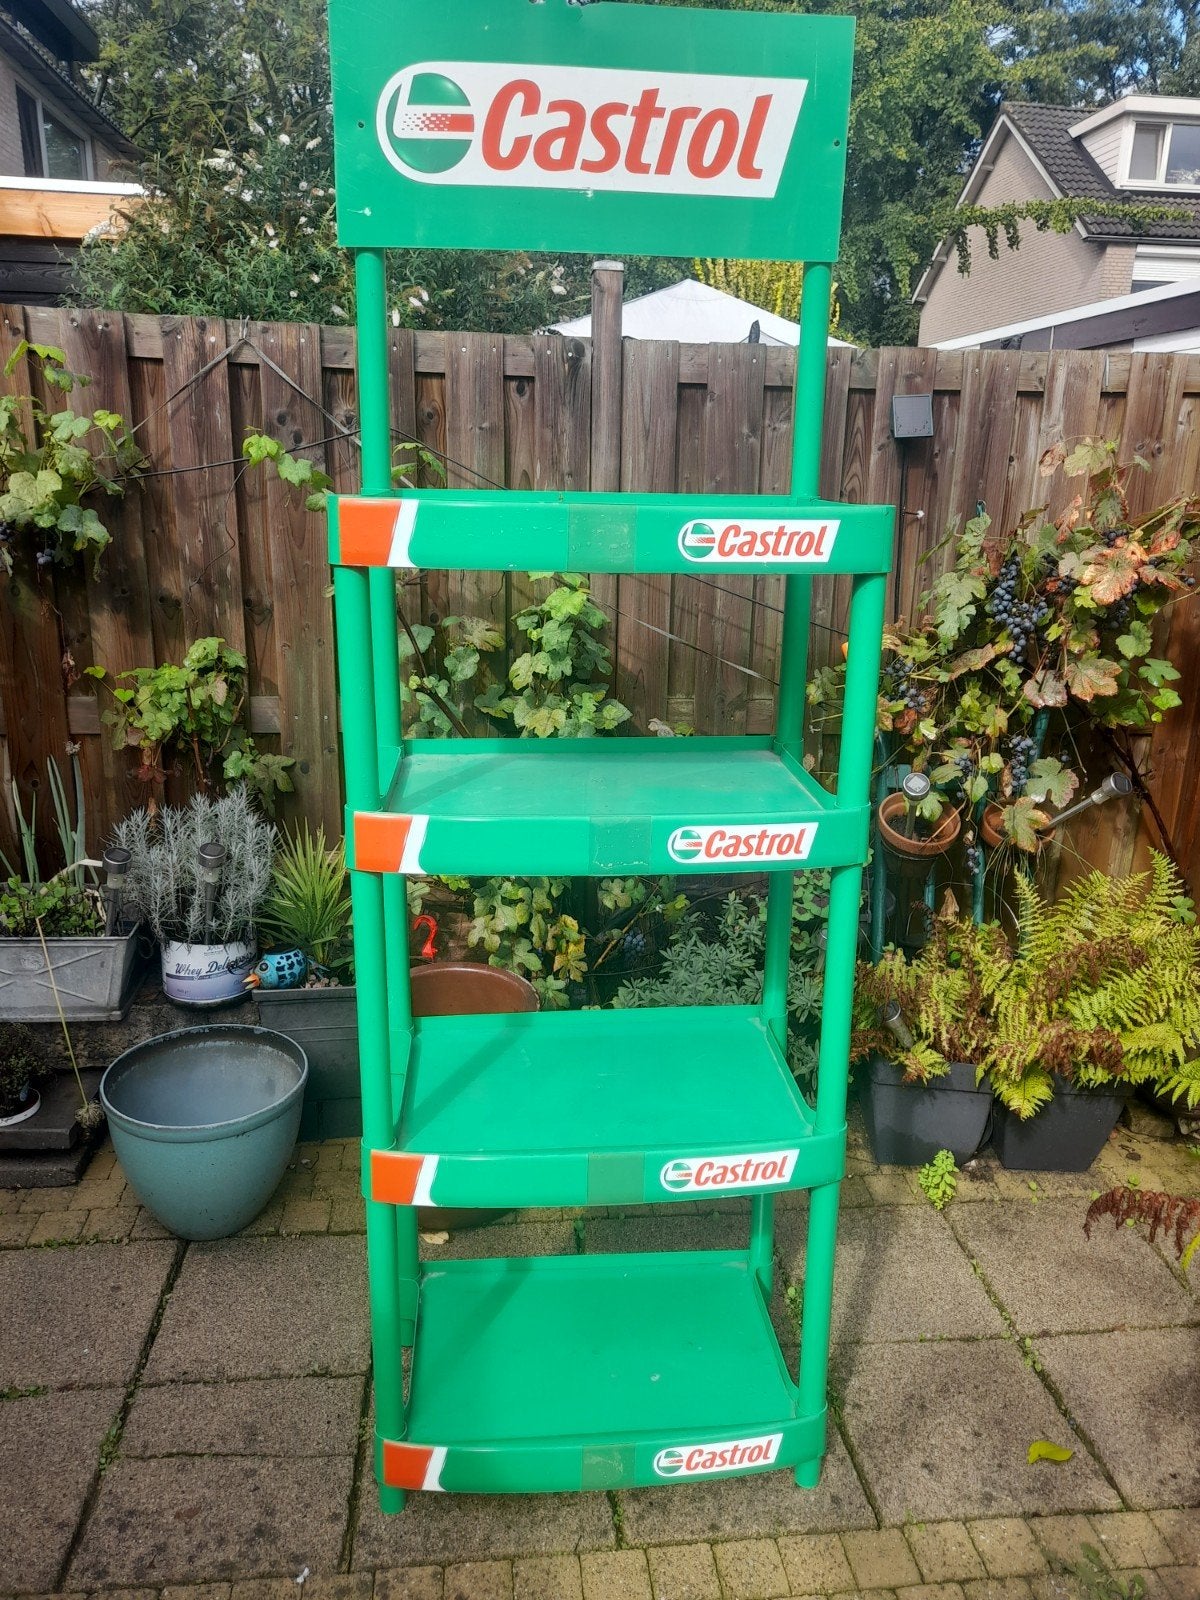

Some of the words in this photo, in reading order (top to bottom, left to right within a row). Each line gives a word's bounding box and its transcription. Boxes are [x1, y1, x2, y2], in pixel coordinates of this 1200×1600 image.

[482, 79, 772, 180] Castrol
[717, 524, 827, 558] Castrol
[704, 828, 806, 858] Castrol
[175, 962, 203, 978] Whey
[694, 1155, 788, 1186] Castrol
[685, 1439, 773, 1471] Castrol
